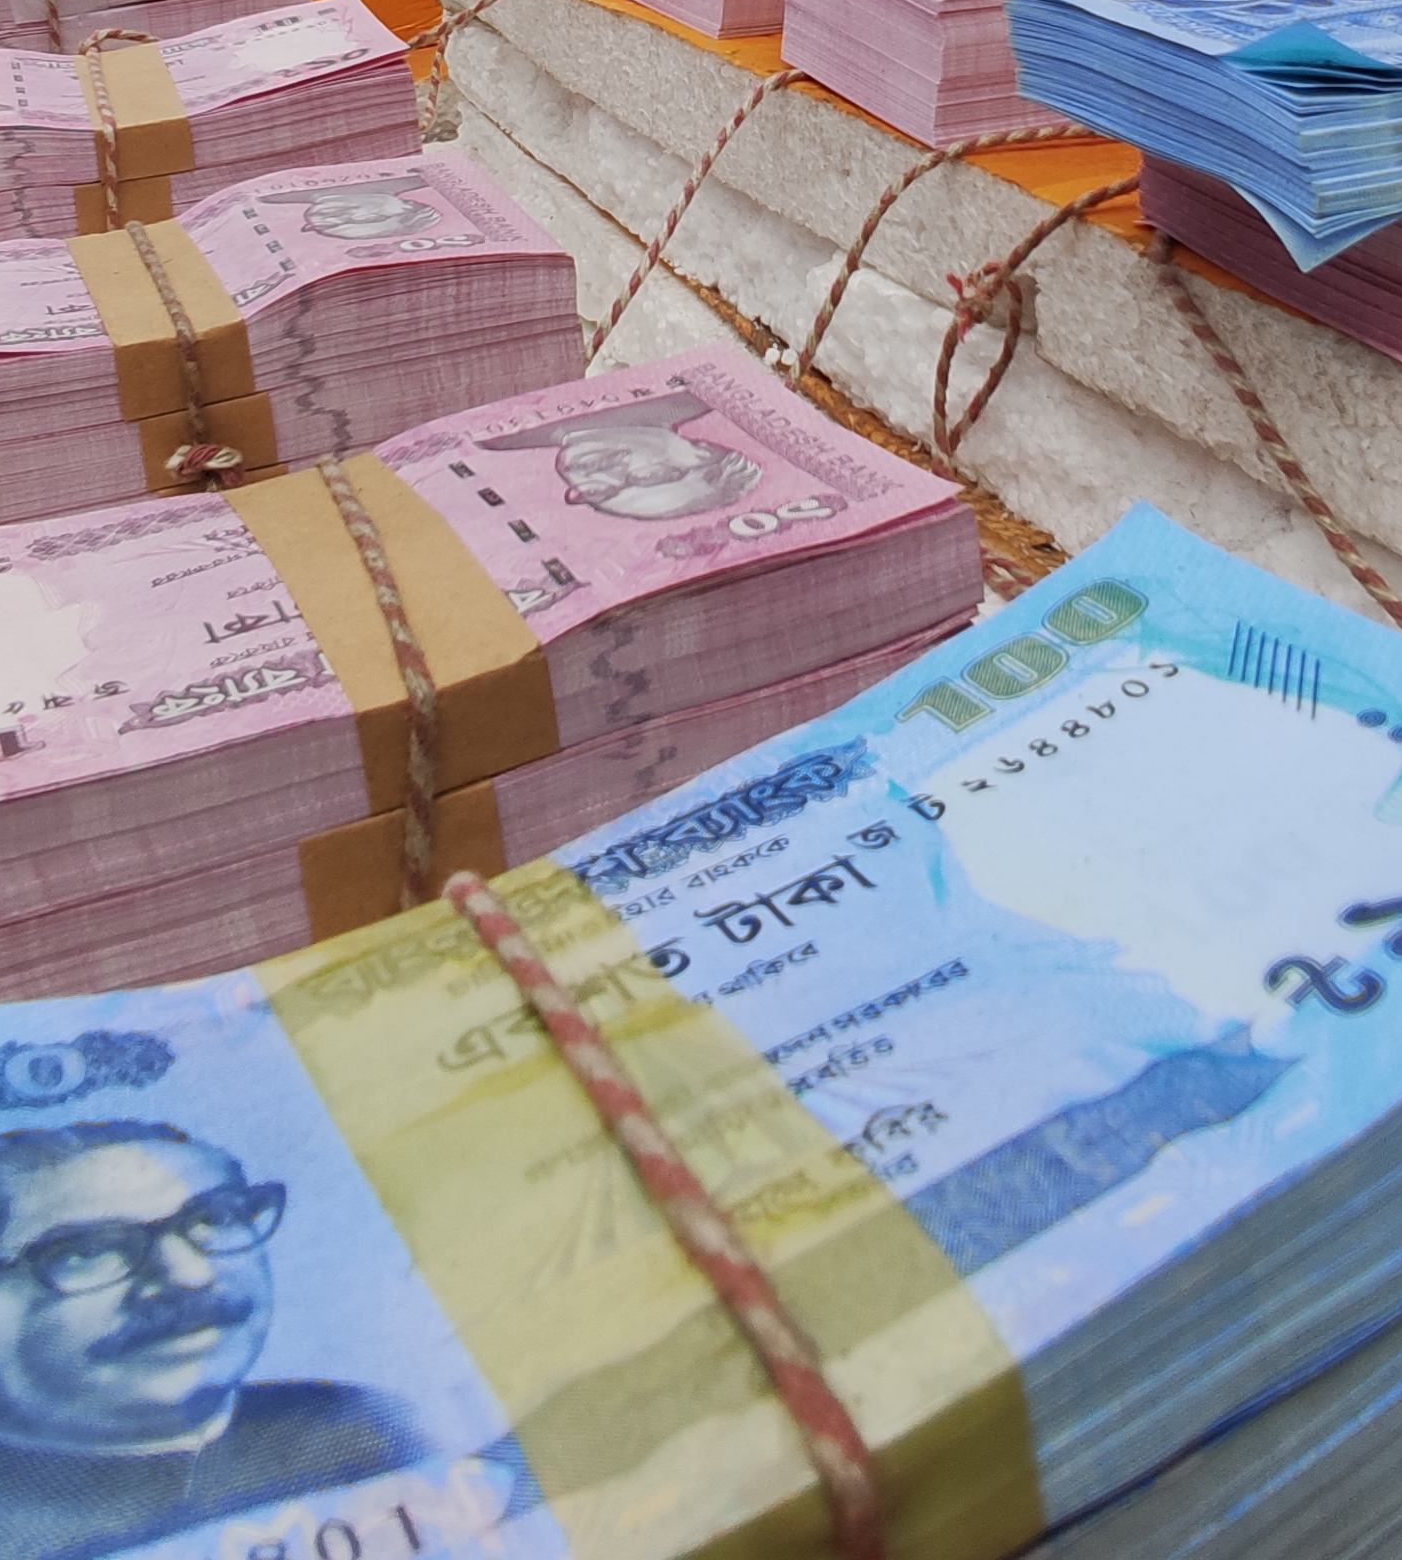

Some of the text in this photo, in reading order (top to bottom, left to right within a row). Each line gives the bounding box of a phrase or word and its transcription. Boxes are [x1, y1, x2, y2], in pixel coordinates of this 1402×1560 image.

[201, 597, 303, 645] াকা
[894, 576, 1151, 735] 100
[151, 663, 305, 722] ব্যাংক
[657, 747, 848, 859] ব্যাংক
[693, 841, 880, 959] টাকা
